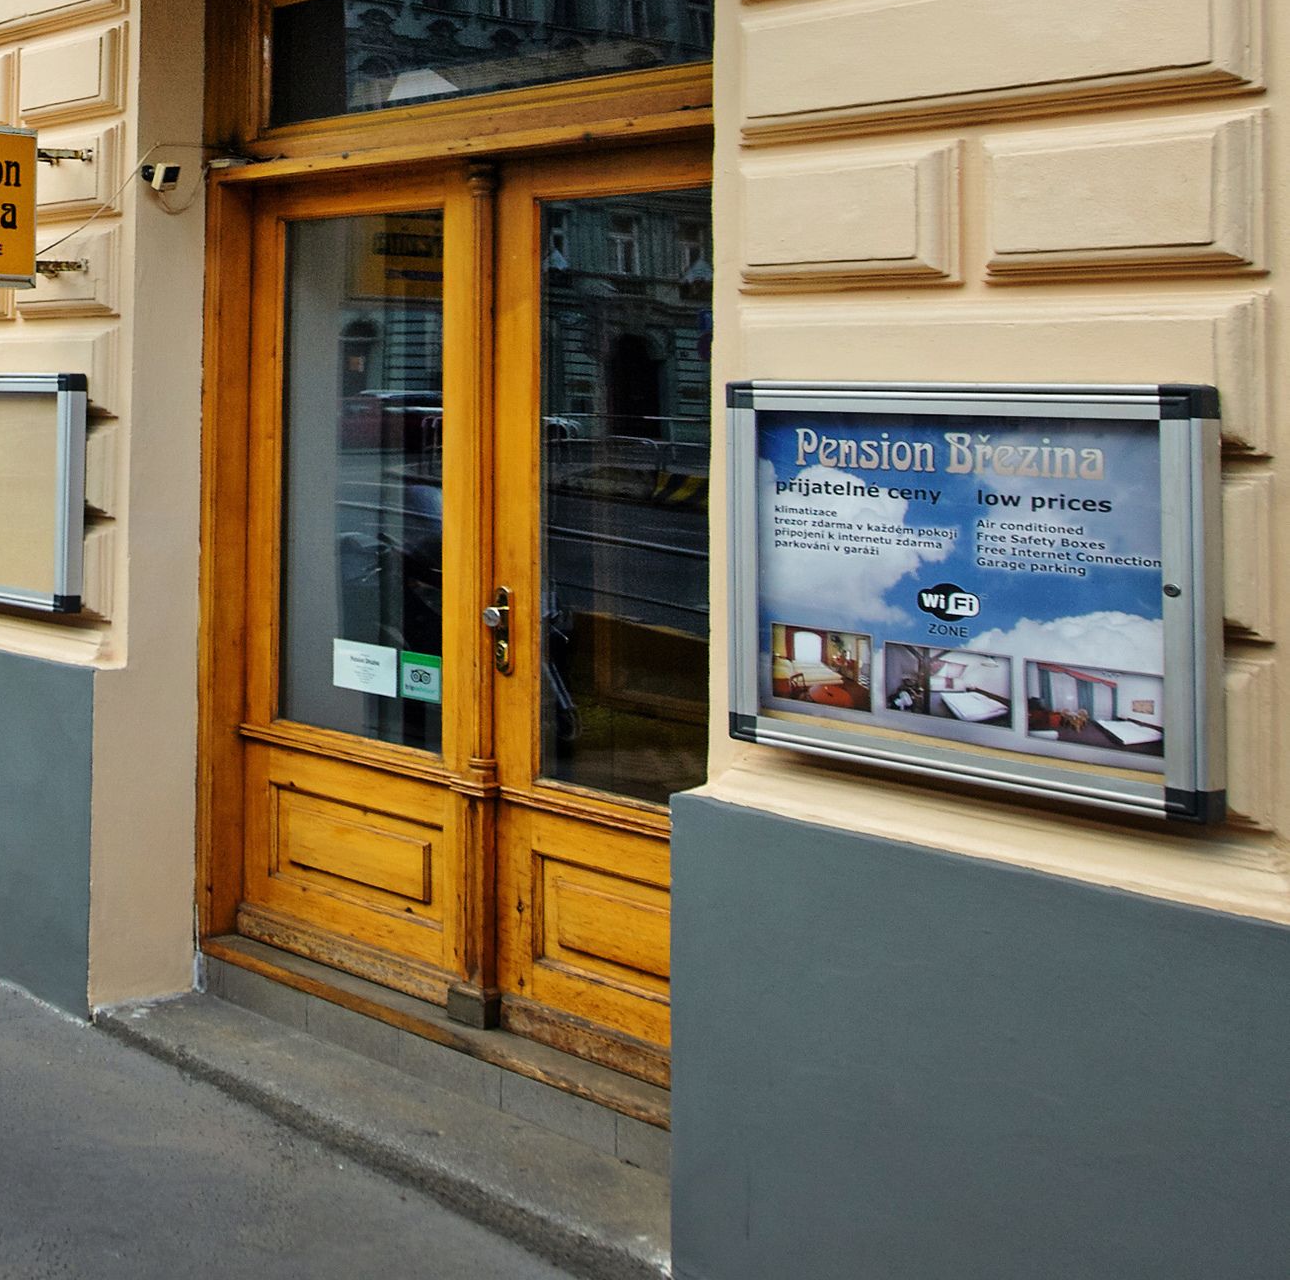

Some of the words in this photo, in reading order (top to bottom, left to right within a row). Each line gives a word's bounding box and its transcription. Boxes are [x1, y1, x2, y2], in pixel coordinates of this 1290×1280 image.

[795, 428, 936, 472] Pension
[943, 431, 1105, 480] Březina
[776, 477, 880, 498] přijatelné
[888, 487, 942, 505] ceny
[977, 490, 1021, 507] low
[1031, 493, 1113, 513] prices
[774, 505, 838, 517] klimatizace
[774, 516, 808, 526] trezor
[811, 519, 853, 530] zdarma
[867, 523, 914, 535] každém
[918, 528, 958, 540] pokoji
[976, 519, 996, 529] Air
[1000, 521, 1084, 535] conditioned
[774, 527, 825, 540] připojení
[828, 531, 835, 540] k
[838, 532, 892, 545] internetu
[896, 537, 943, 549] zdarma
[774, 539, 830, 551] parkování
[844, 543, 879, 555] garáži
[976, 532, 1006, 543] Free
[1010, 534, 1056, 548] Safety
[1061, 538, 1106, 550] Boxes
[976, 545, 1006, 555] Free
[1011, 547, 1072, 561] Internet
[1076, 552, 1162, 568] Connection
[976, 557, 1027, 571] Garage
[1030, 563, 1087, 577] parking
[928, 623, 969, 638] ZONE
